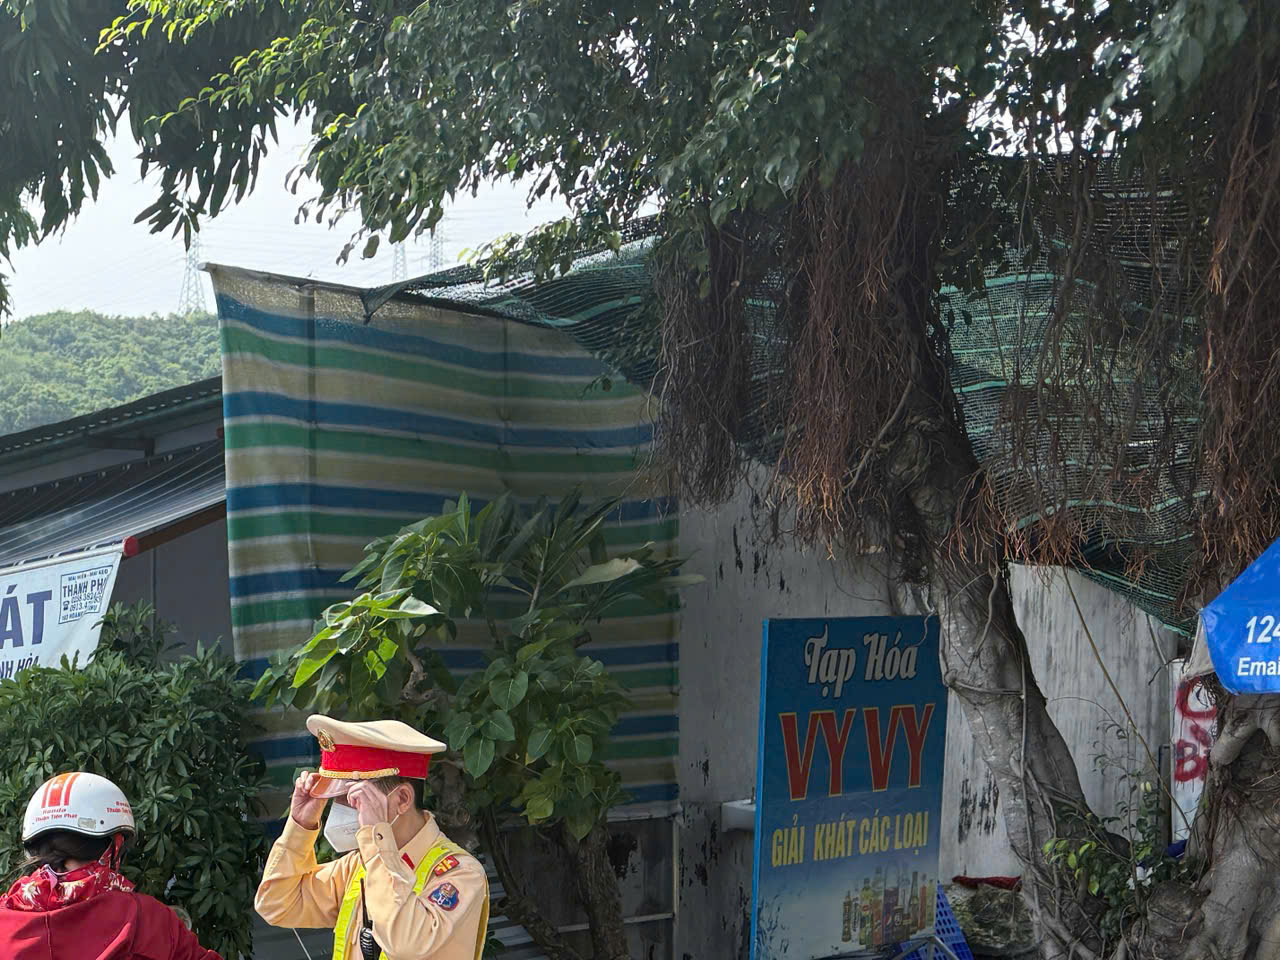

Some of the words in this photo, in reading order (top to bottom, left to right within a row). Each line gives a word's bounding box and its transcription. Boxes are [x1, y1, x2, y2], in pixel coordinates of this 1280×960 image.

[804, 623, 857, 698] Tạp
[863, 631, 919, 681] Hóa
[779, 707, 857, 801] VY
[863, 703, 936, 792] VY
[772, 814, 805, 867] GIẢI
[813, 813, 856, 861] KHÁT
[859, 809, 891, 855] CÁC
[894, 811, 929, 855] LOẠI
